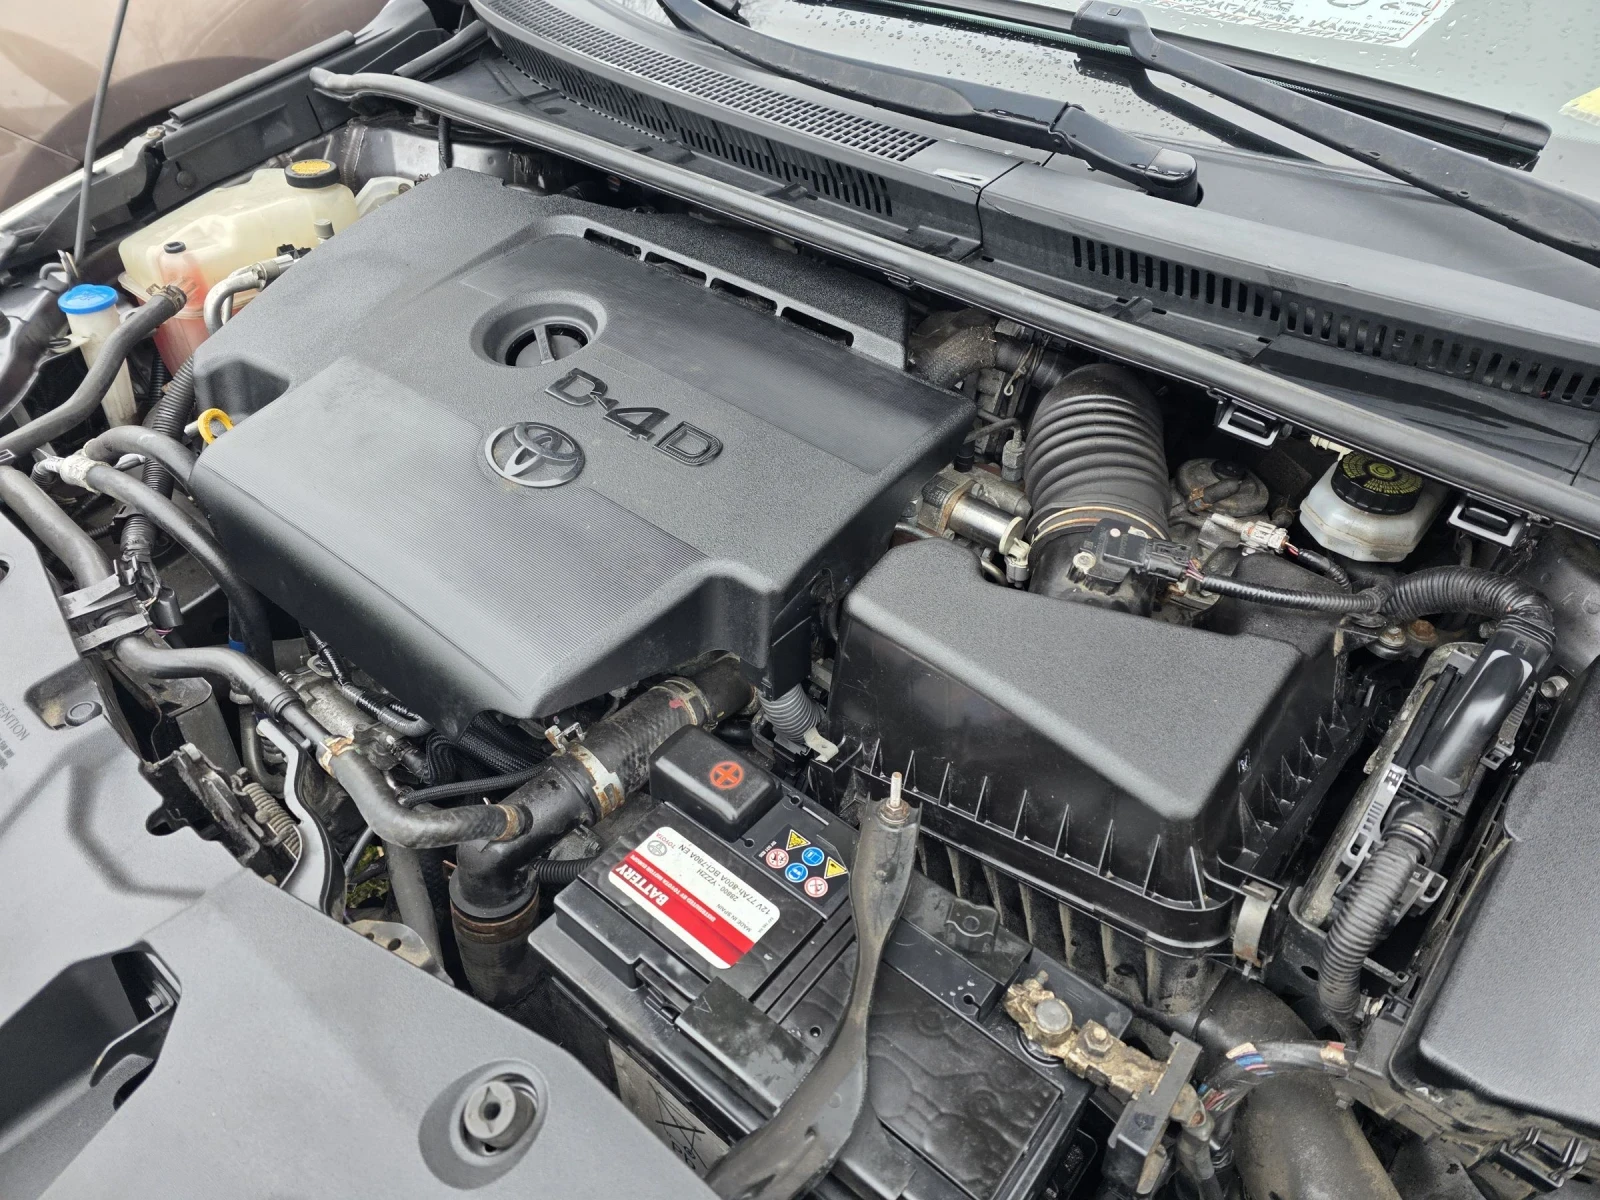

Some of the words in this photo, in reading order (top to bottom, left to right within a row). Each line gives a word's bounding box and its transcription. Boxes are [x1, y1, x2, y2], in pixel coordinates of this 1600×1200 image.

[544, 367, 724, 466] D-4D
[655, 831, 675, 849] TOYOTA
[678, 843, 690, 854] EN
[630, 854, 647, 868] EUROPE
[645, 865, 664, 881] MOTOR
[615, 863, 669, 906] BATTERY
[661, 877, 680, 894] TOYOTA
[679, 892, 688, 900] BY
[719, 885, 738, 901] 28800
[685, 896, 716, 922] DISTRIBUTED
[716, 903, 732, 917] SPAIN
[755, 903, 770, 915] 12V
[736, 918, 751, 932] MADE
